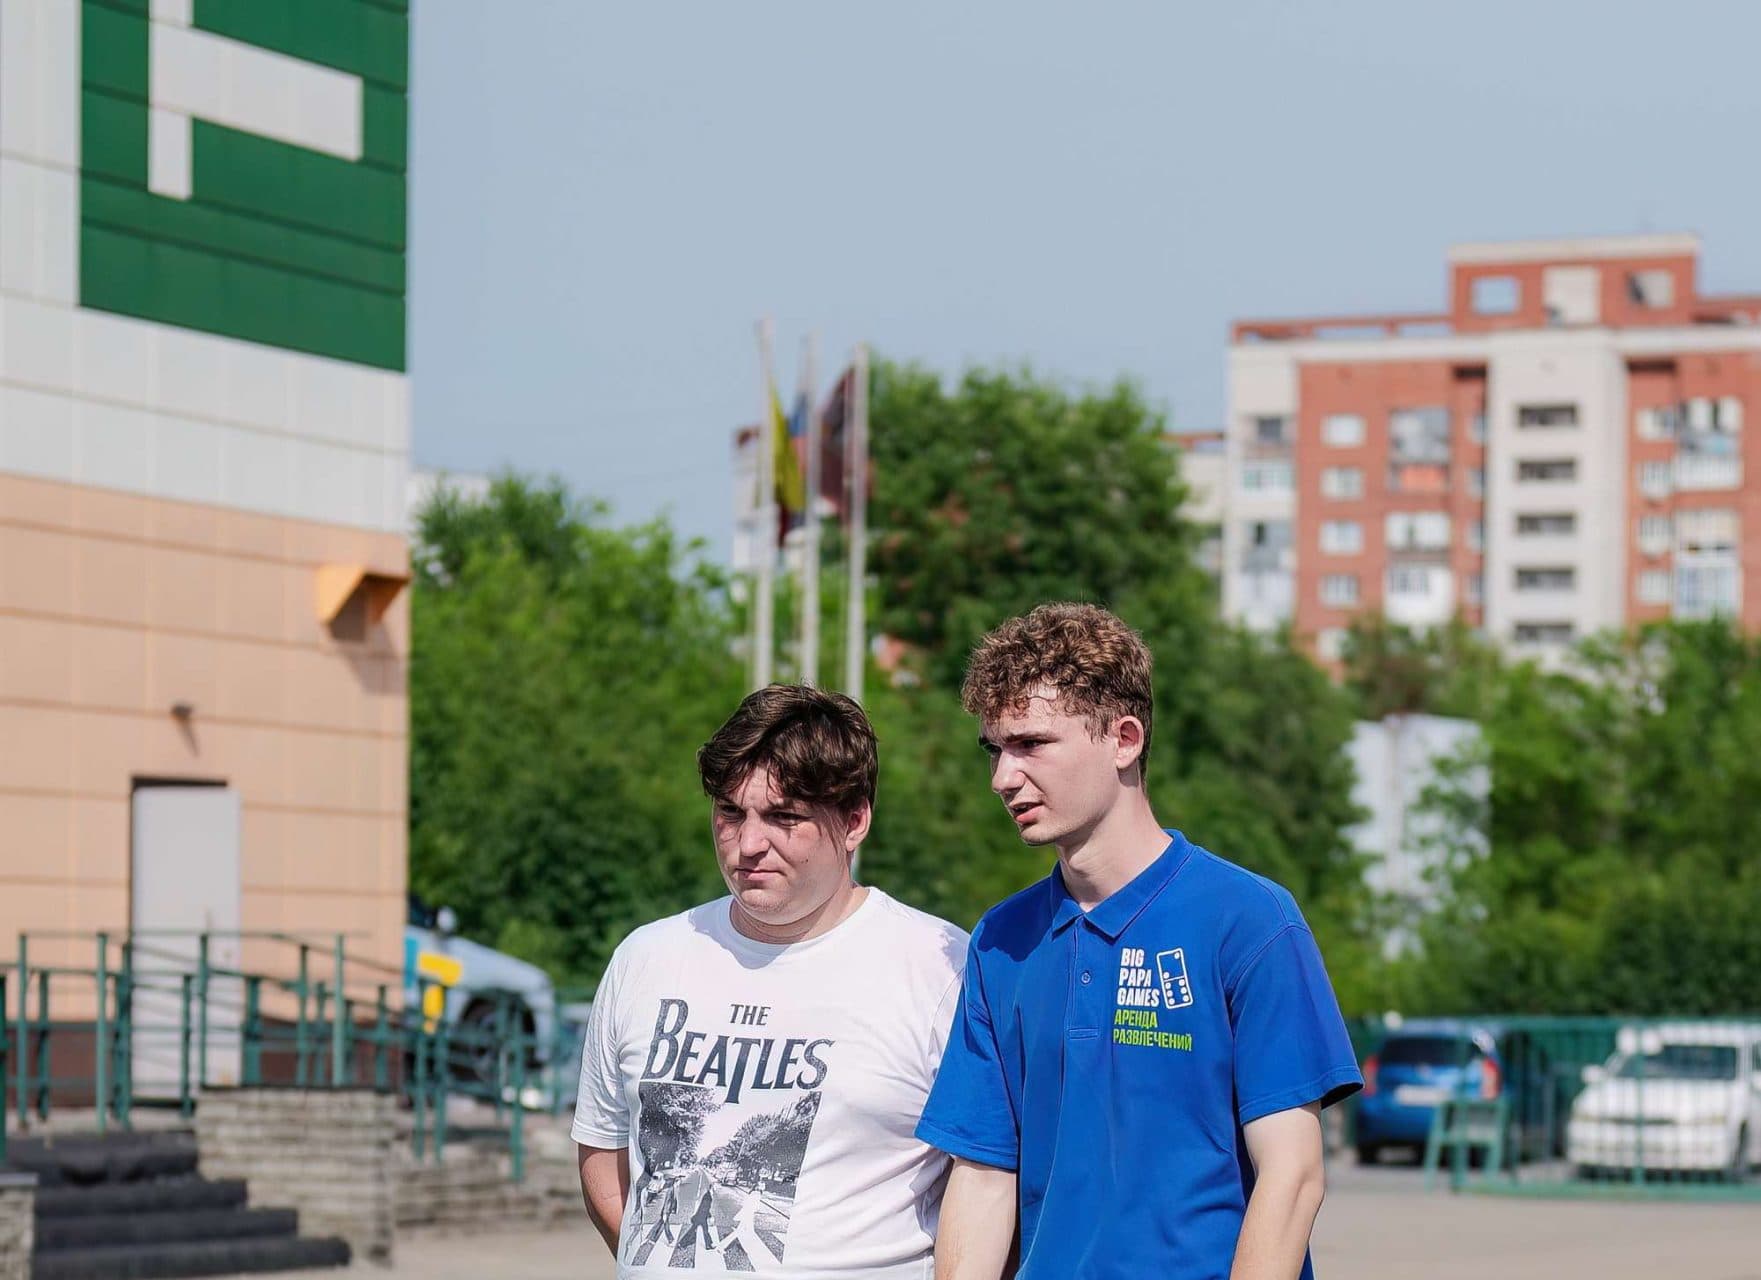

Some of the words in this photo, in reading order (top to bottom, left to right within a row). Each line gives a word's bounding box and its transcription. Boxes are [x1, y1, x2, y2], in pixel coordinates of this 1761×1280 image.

[1121, 948, 1145, 967] BIG
[1119, 968, 1152, 987] PAPA
[1117, 988, 1160, 1007] GAMES
[730, 1003, 771, 1026] THE
[1114, 1009, 1158, 1028] АРЕНДА
[1113, 1029, 1192, 1051] РАЗВЛЕЧЕНИЙ
[640, 999, 835, 1104] BEATLES
